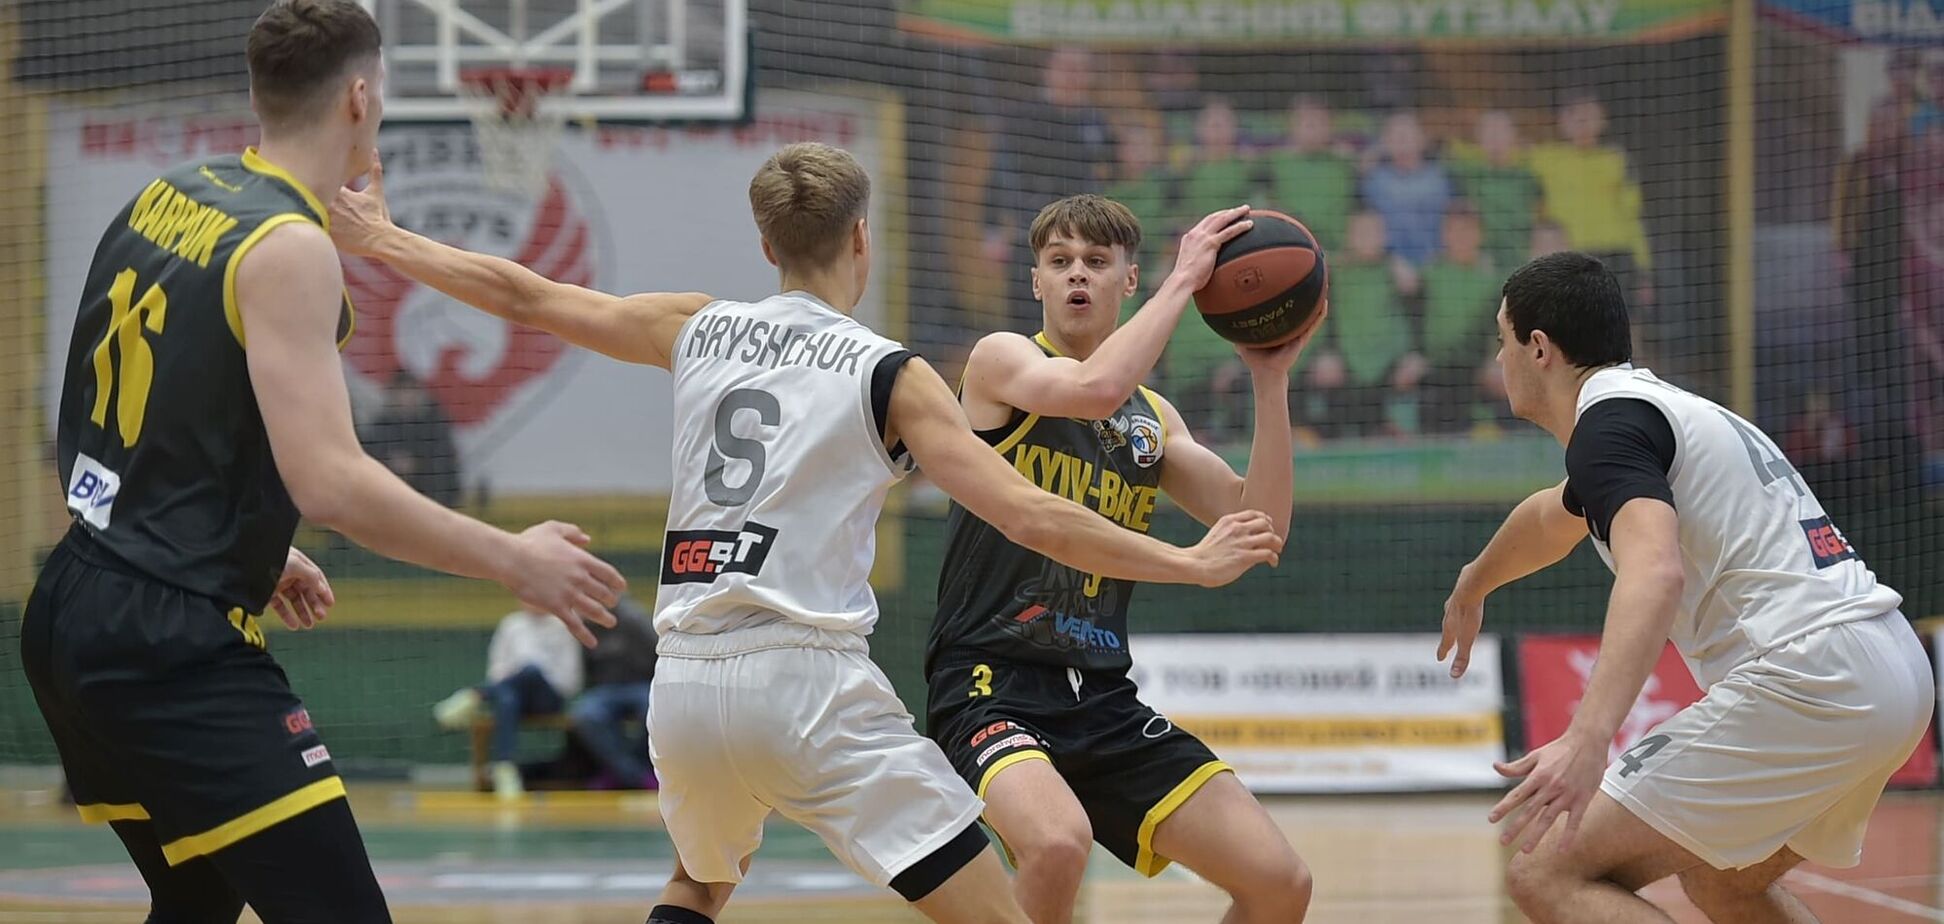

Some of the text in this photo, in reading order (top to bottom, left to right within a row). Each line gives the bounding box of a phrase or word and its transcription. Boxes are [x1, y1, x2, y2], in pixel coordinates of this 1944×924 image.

[128, 177, 239, 269] KARPUK
[90, 267, 167, 448] 16
[1717, 409, 1806, 497] 4
[968, 664, 993, 697] 3
[1618, 734, 1672, 779] 4
